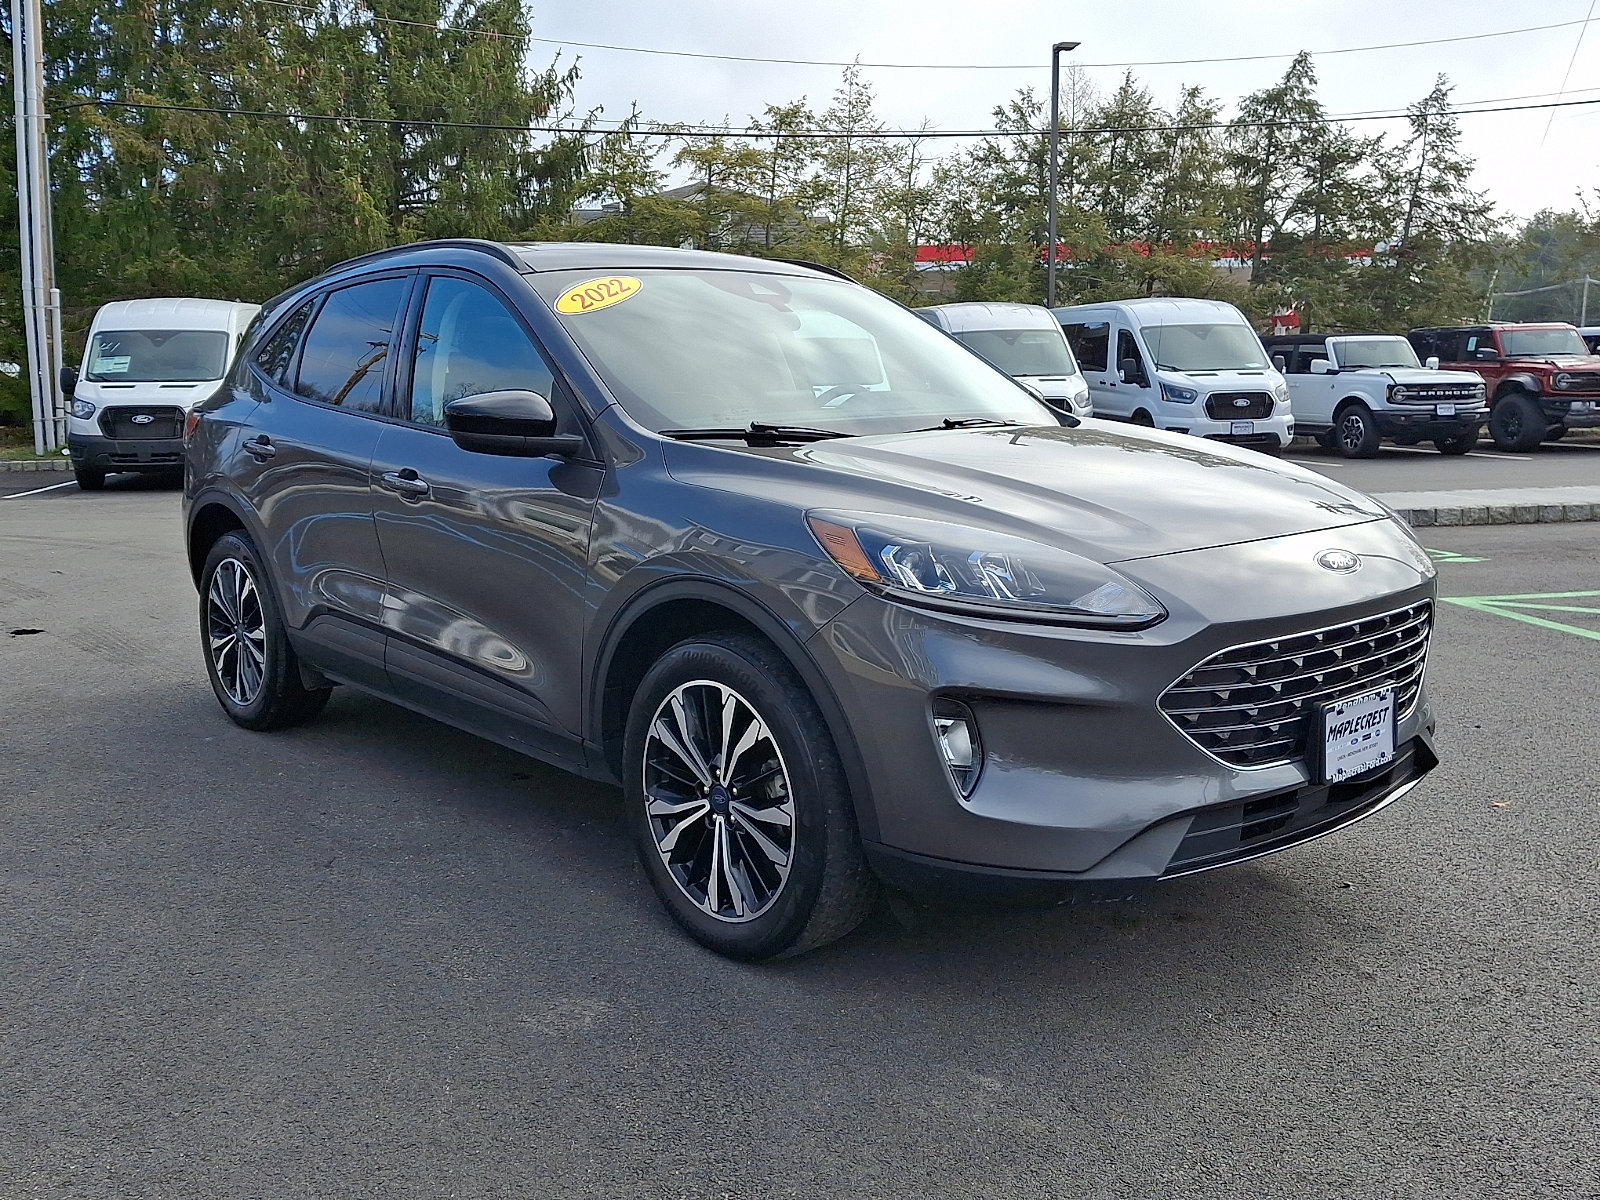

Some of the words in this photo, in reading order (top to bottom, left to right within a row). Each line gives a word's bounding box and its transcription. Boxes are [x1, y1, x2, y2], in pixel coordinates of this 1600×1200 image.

[570, 279, 632, 310] 2022
[1321, 551, 1357, 570] Ford
[1326, 706, 1390, 742] MAPLECREST
